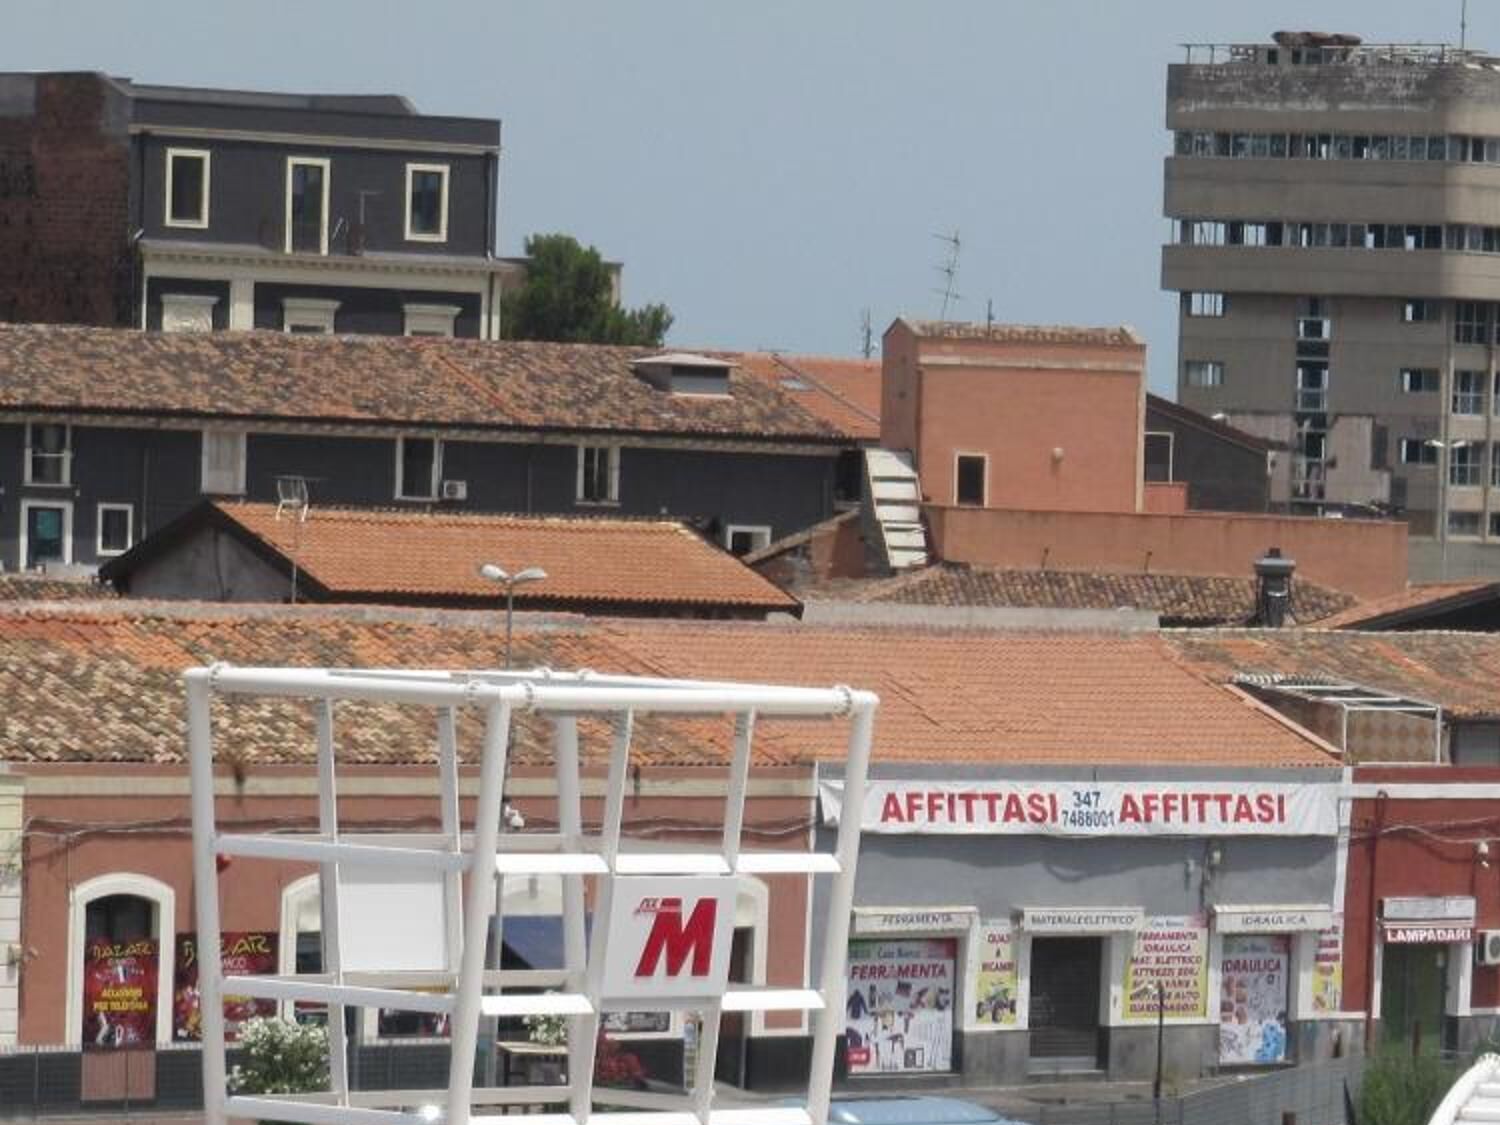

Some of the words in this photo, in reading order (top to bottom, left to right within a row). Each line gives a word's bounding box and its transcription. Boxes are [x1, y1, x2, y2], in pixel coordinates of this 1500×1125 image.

[880, 792, 1057, 824] AFFITTASI
[1072, 791, 1101, 808] 347
[1119, 793, 1285, 823] AFFITTASI
[1242, 915, 1307, 926] IDRAULICA
[634, 897, 718, 977] M
[1387, 928, 1471, 943] LAMPADARI
